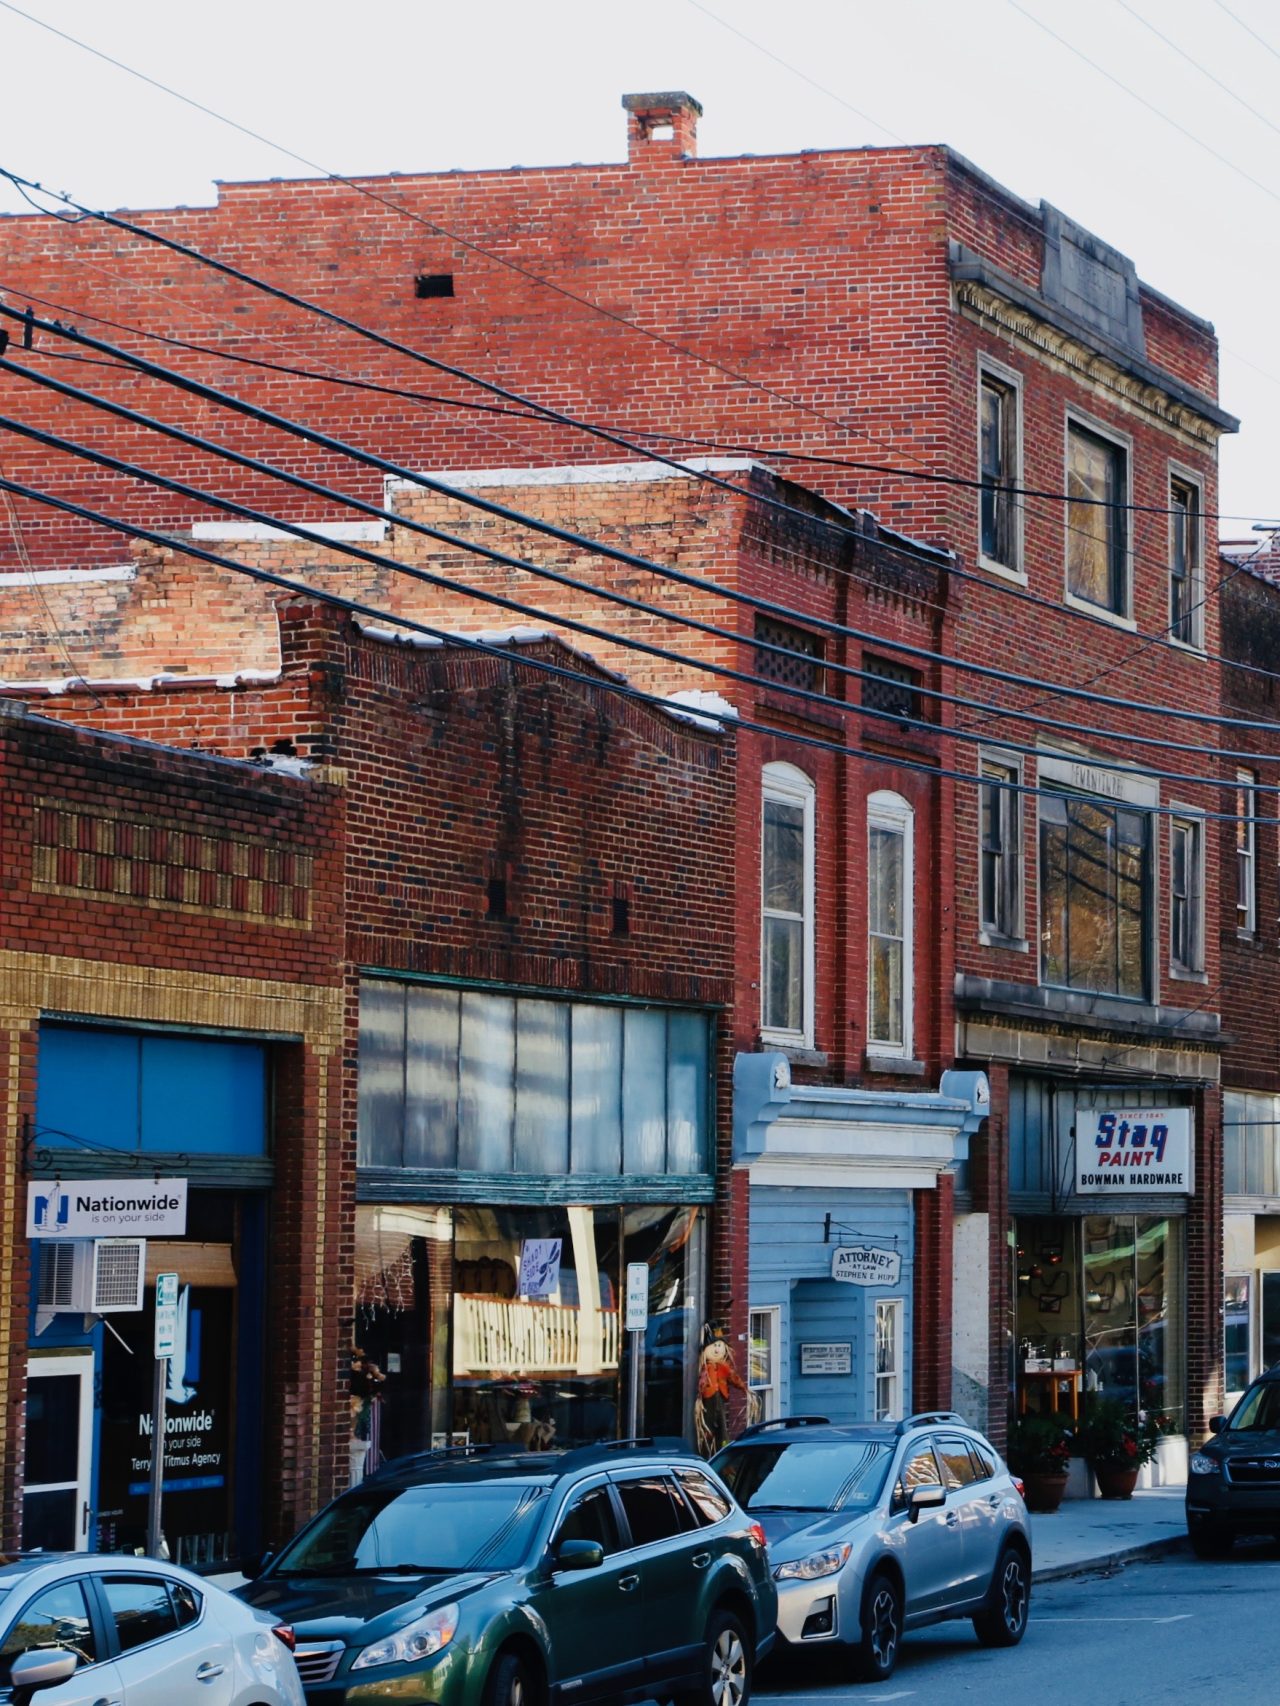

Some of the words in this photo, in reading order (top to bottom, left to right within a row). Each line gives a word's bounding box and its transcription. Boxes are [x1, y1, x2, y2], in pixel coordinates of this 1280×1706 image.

[1095, 1114, 1169, 1163] Stag
[1098, 1151, 1154, 1167] PAINT
[1081, 1173, 1125, 1185] BOWMAN
[1130, 1173, 1183, 1185] HARDWARE
[76, 1194, 179, 1212] Nationwide
[91, 1213, 100, 1223] is
[102, 1214, 116, 1222] on
[118, 1213, 142, 1225] your
[144, 1212, 166, 1222] side
[838, 1251, 894, 1269] ATTORNEY
[835, 1270, 868, 1280] STEPHEN
[139, 1410, 212, 1435] Nionwide
[168, 1439, 184, 1451] your
[186, 1436, 202, 1448] side
[131, 1457, 152, 1472] Terry
[164, 1454, 190, 1467] Titmus
[191, 1452, 221, 1467] Agency
